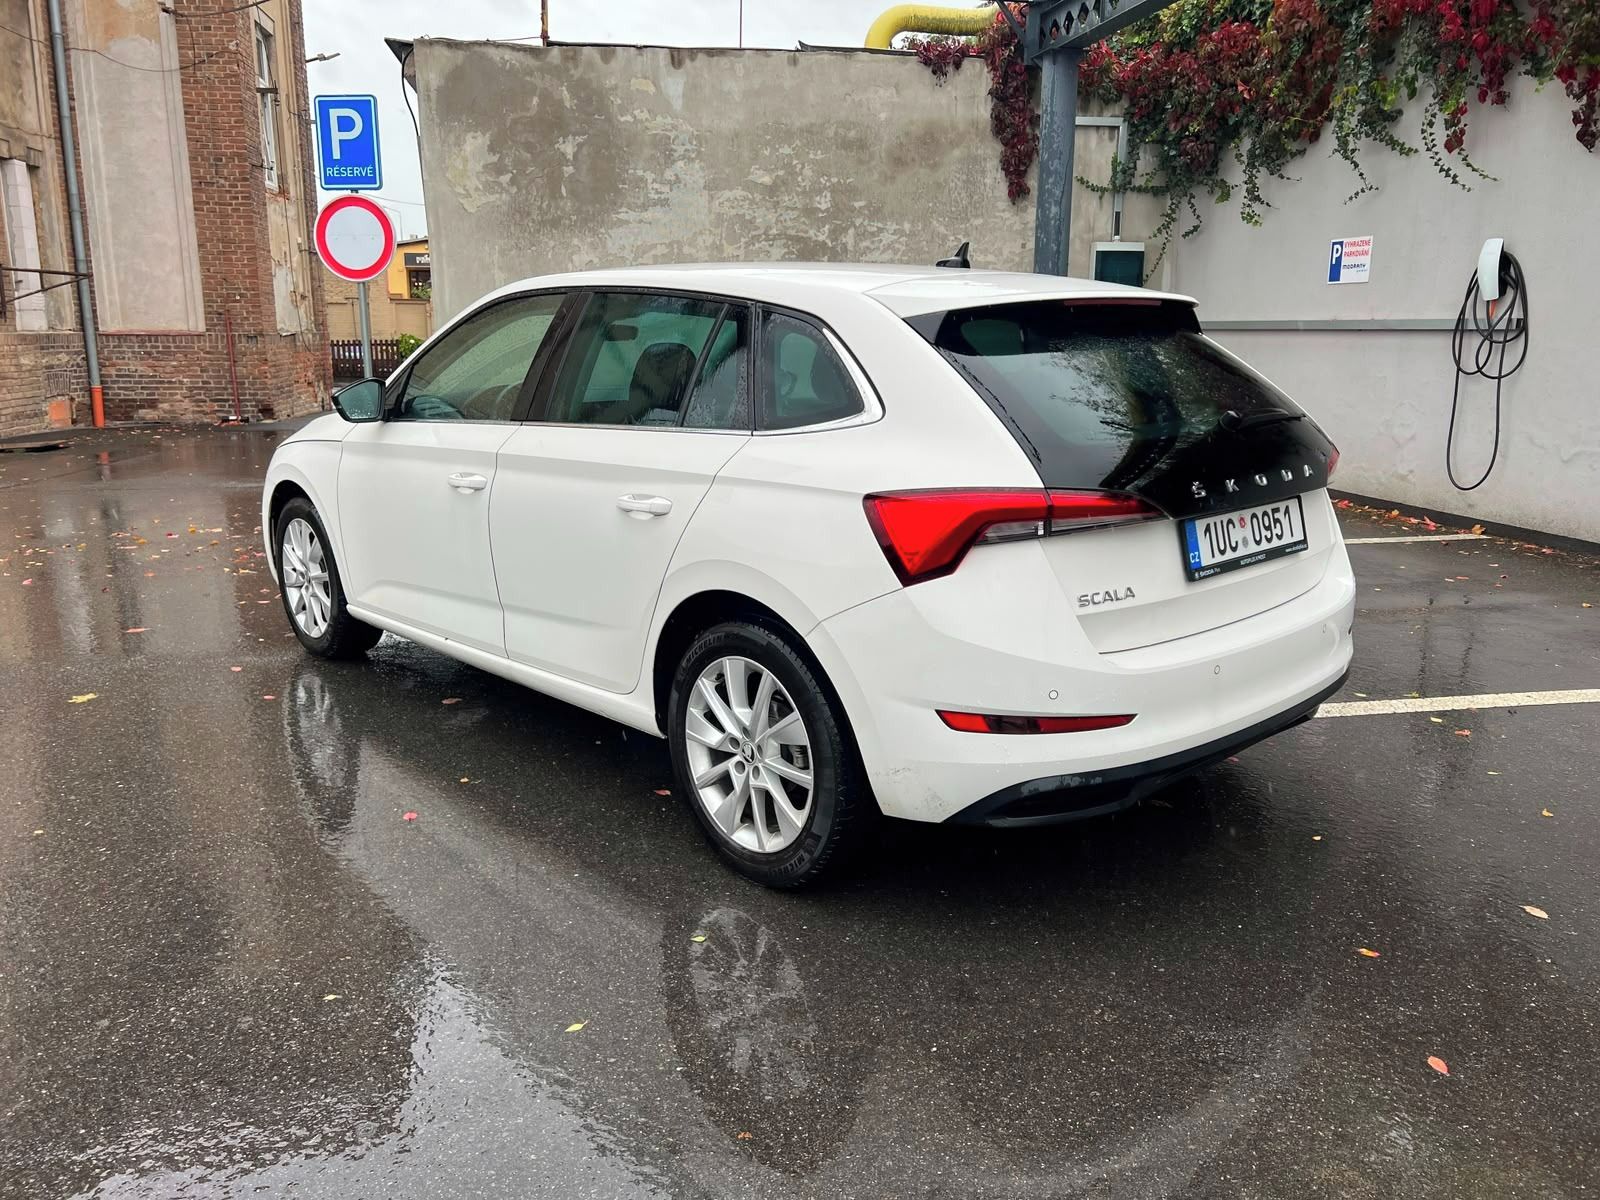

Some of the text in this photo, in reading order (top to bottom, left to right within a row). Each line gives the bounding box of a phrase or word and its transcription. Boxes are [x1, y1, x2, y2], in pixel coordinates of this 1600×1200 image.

[328, 107, 363, 160] P
[326, 164, 374, 177] RÉSERVÉ
[1343, 248, 1369, 257] PARKOVÁNÍ
[1344, 239, 1371, 248] VYHRAZENÉ
[1332, 244, 1342, 265] P
[1191, 464, 1314, 498] ŠKODA
[1203, 505, 1294, 559] 1UC 0951
[1189, 552, 1200, 563] CZ
[1078, 586, 1136, 608] SCALA
